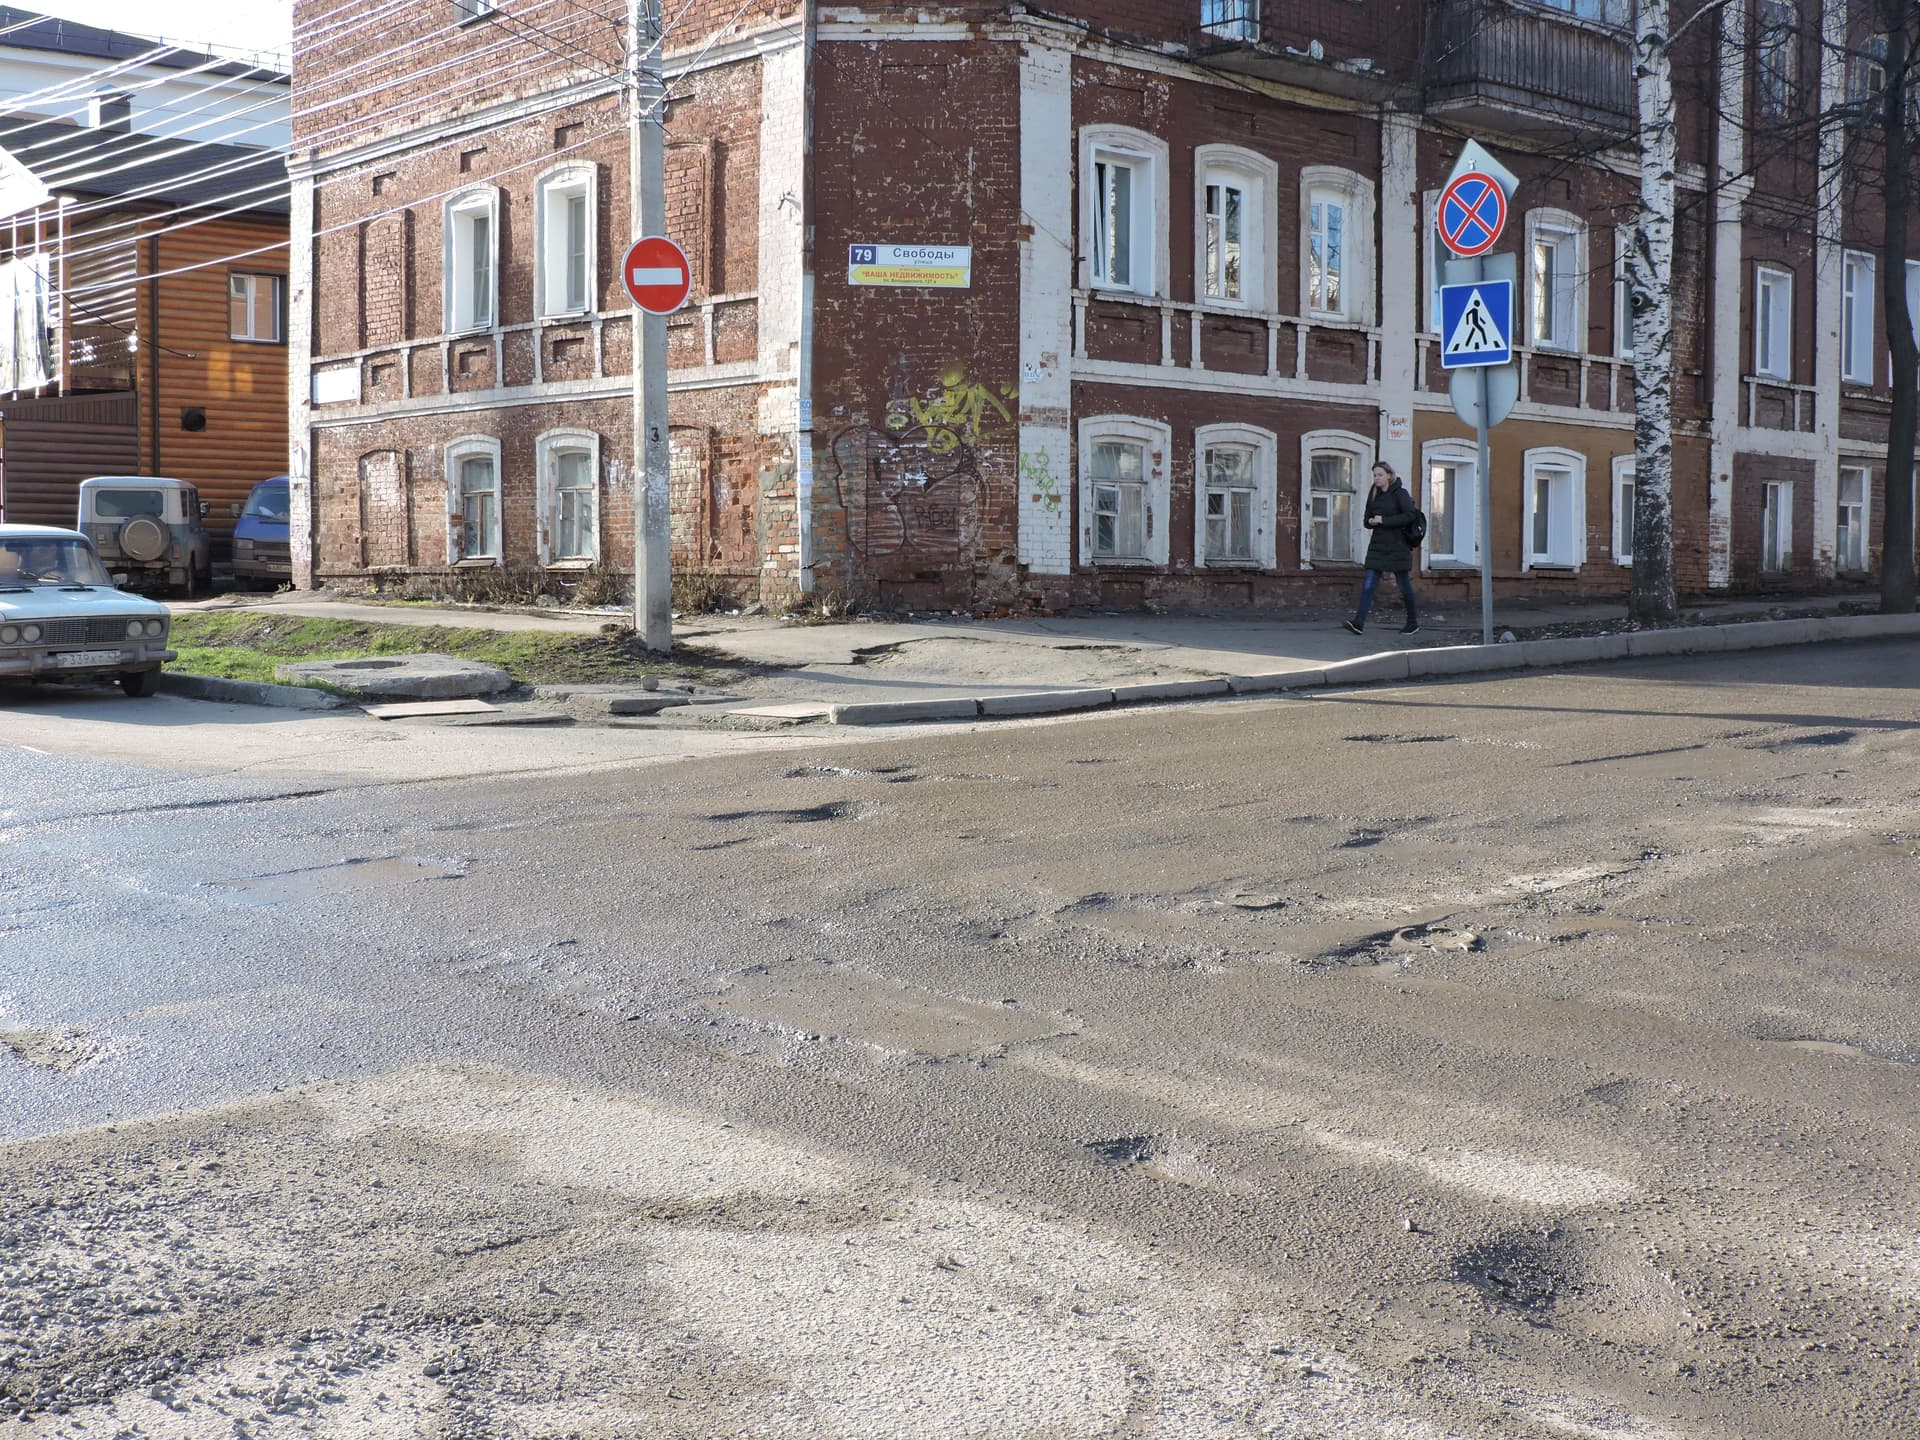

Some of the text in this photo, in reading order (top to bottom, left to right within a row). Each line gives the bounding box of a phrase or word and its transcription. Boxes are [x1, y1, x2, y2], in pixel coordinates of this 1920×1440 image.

[855, 249, 872, 261] 79
[893, 247, 954, 260] Свободы
[889, 271, 959, 280] НЕДВИЖИМОСТЬ"
[651, 427, 659, 442] 3
